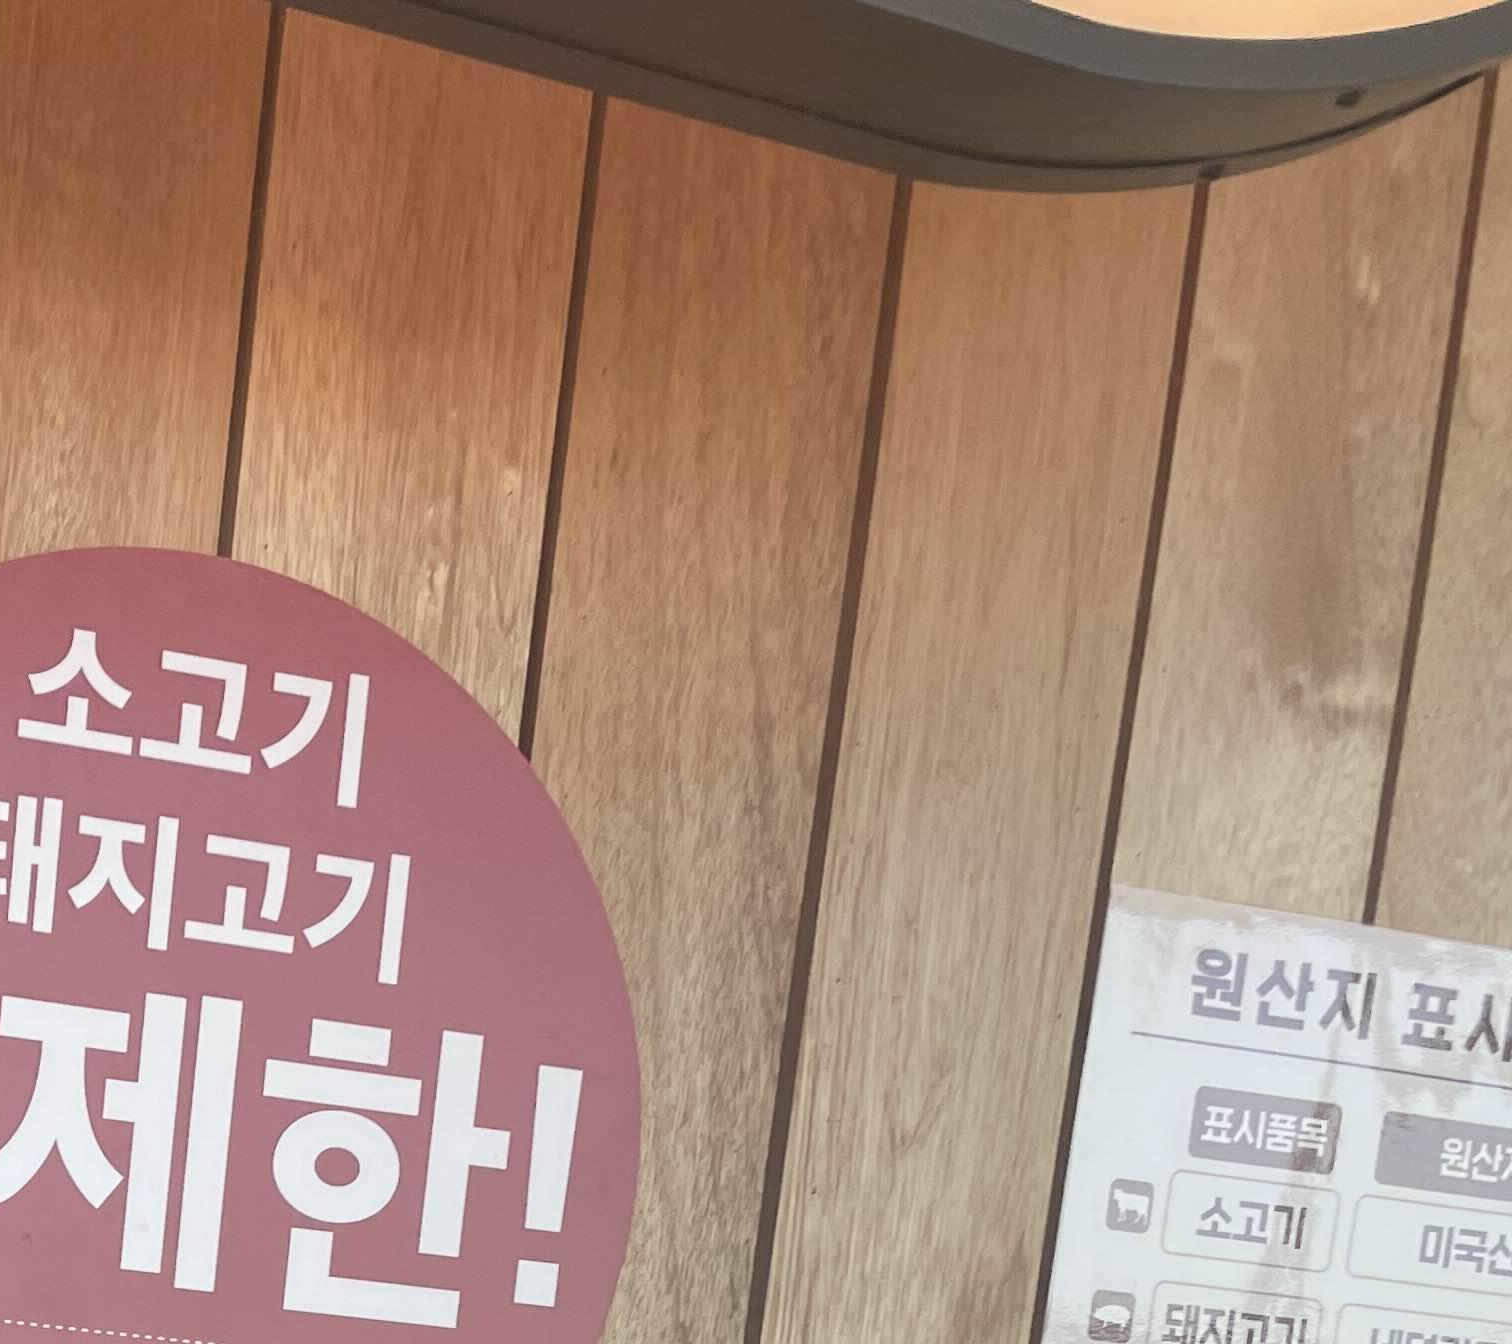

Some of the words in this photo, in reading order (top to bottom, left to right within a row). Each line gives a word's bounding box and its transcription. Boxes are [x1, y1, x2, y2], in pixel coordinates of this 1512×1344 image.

[18, 627, 370, 808] 소고기
[1189, 948, 1378, 1040] 원산지
[1200, 1104, 1329, 1157] 표시품목
[1194, 1196, 1308, 1250] 소고기
